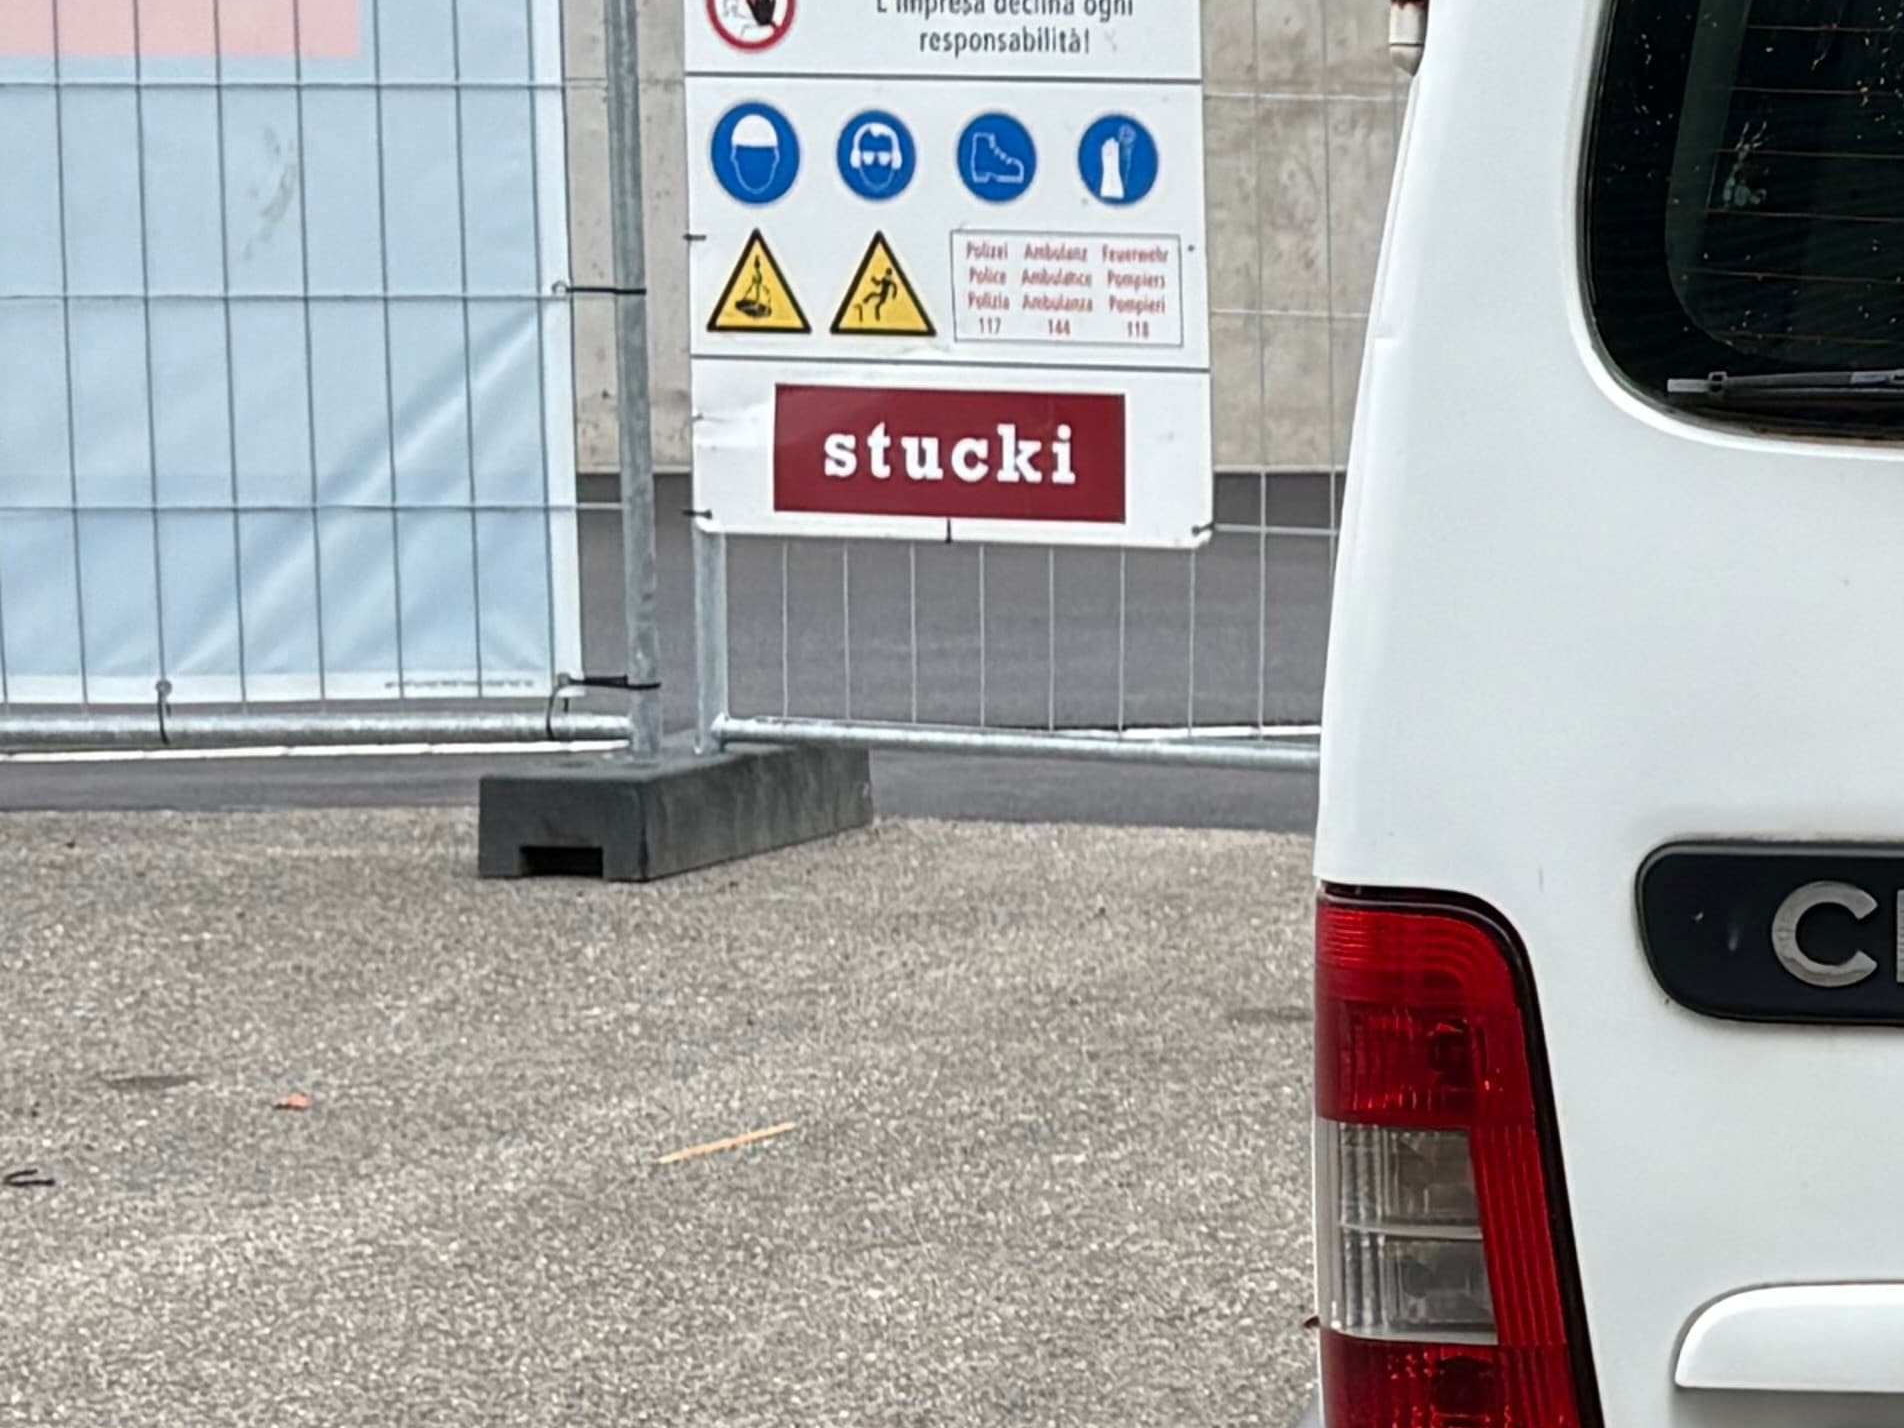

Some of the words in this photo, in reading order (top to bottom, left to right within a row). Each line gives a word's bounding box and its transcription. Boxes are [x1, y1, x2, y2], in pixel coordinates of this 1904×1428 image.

[919, 25, 1090, 59] responsabilità!
[969, 266, 1006, 285] Police
[979, 317, 1001, 335] 117
[1127, 321, 1150, 339] 118
[824, 421, 1076, 485] stucki
